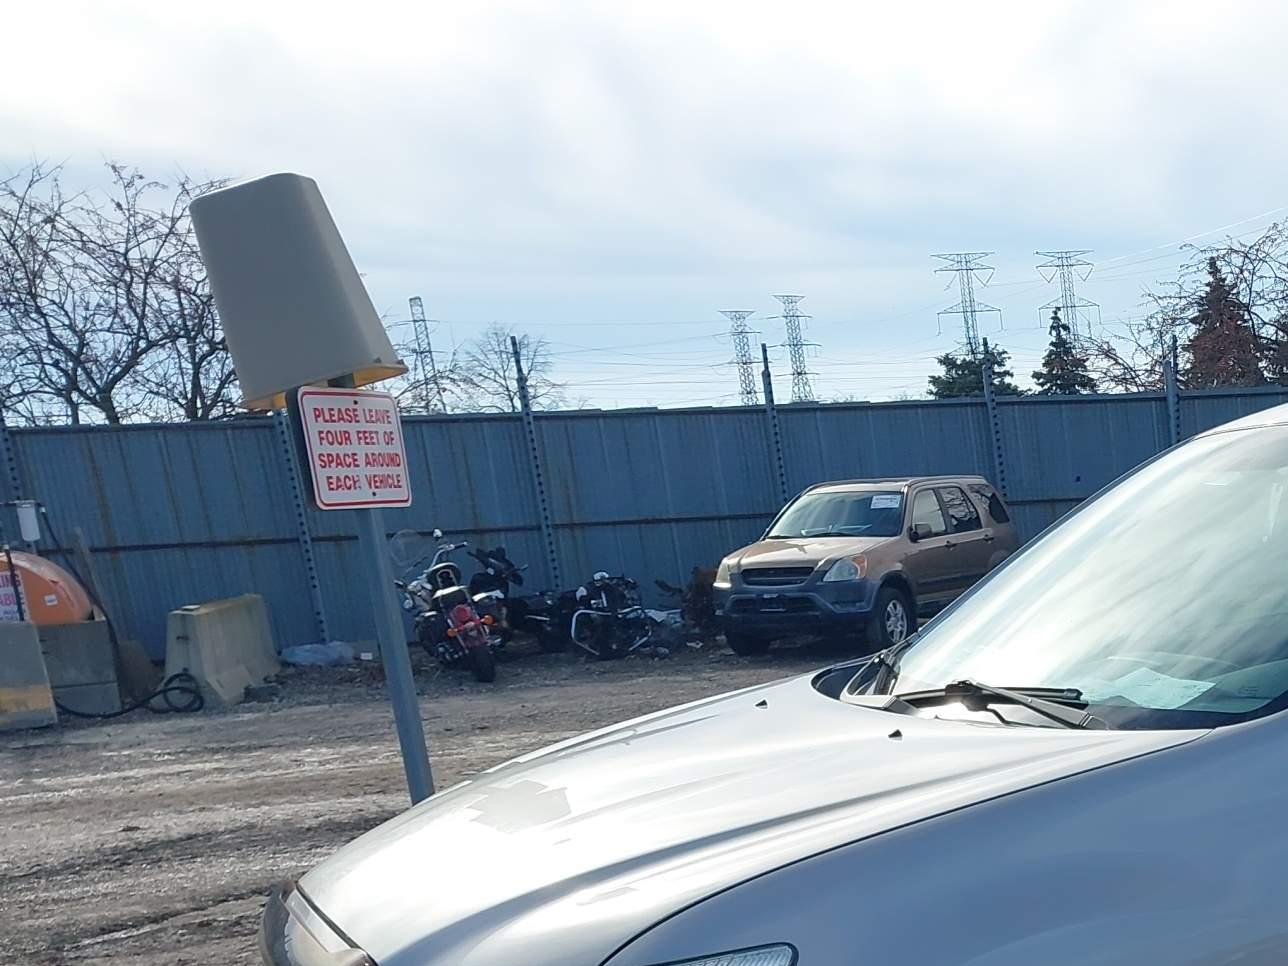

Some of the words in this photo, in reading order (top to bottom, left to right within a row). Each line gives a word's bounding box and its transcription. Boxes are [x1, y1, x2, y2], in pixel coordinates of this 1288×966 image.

[313, 407, 360, 424] PLEASE
[363, 408, 393, 425] LEAVE
[318, 430, 352, 446] FOUR
[356, 430, 381, 446] FEET
[384, 430, 395, 446] OF
[318, 452, 361, 469] SPACE
[365, 452, 402, 468] AROUND
[326, 474, 362, 491] EACH
[365, 474, 403, 489] VEHICLE
